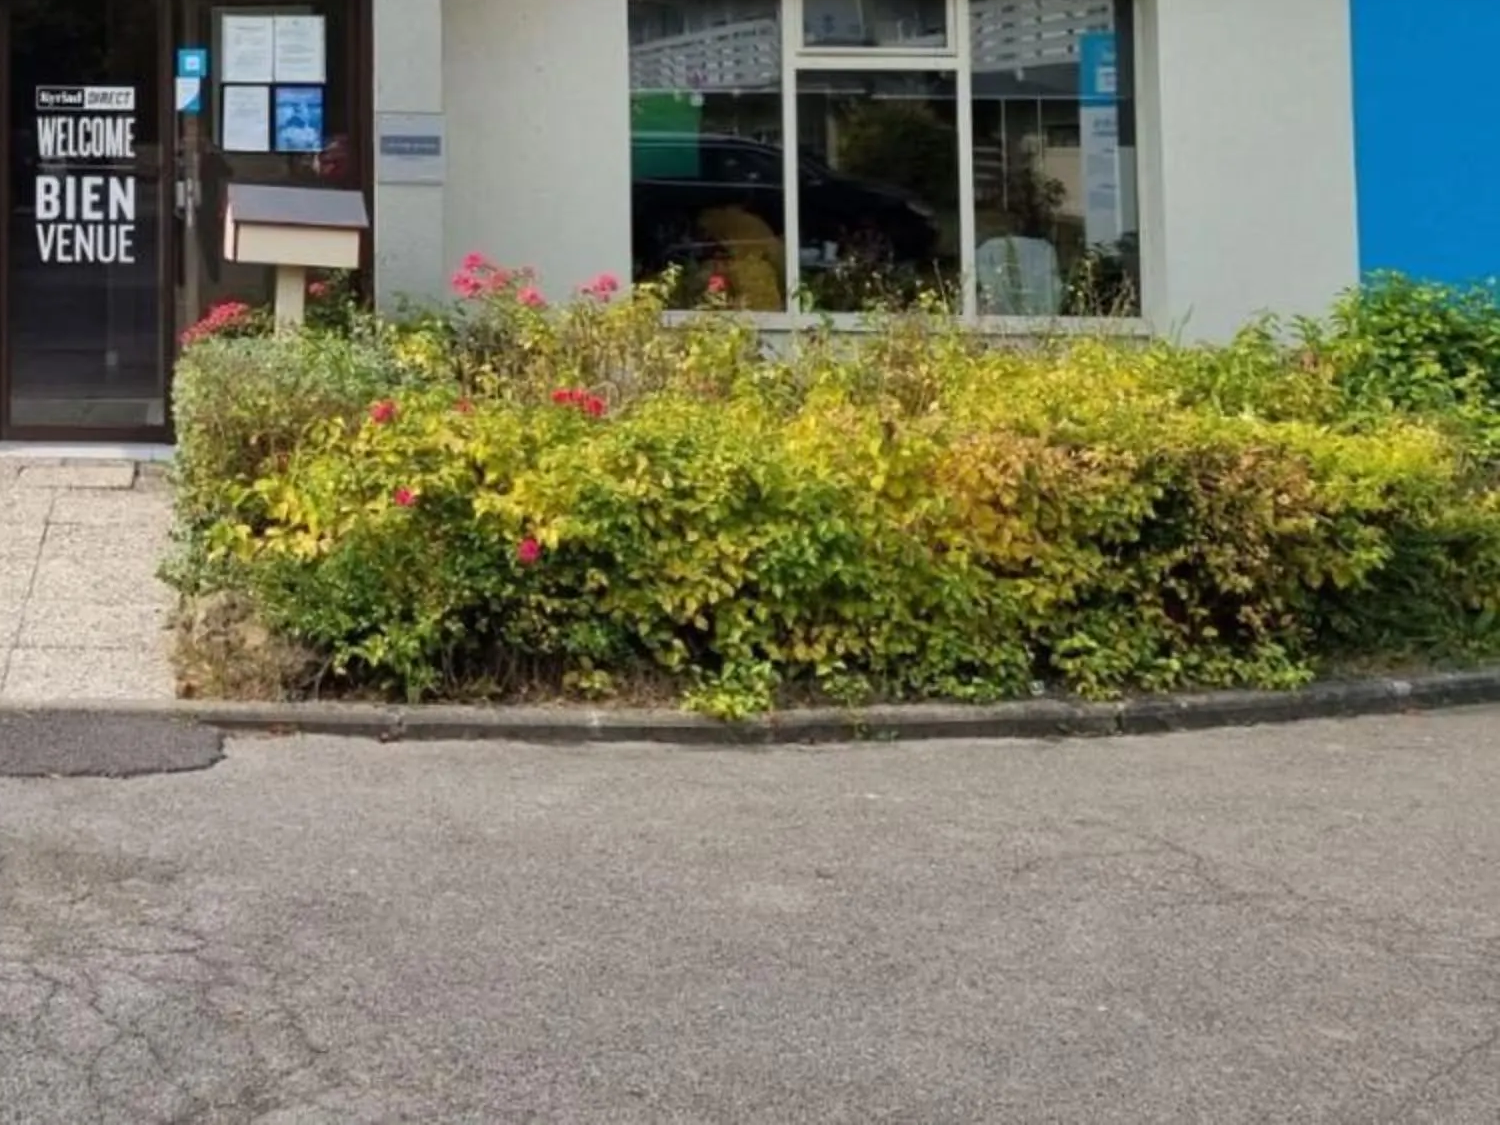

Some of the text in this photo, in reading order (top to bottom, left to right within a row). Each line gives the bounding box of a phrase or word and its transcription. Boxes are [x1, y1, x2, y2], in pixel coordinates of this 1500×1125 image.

[41, 90, 132, 106] Kyriad DIRECT
[37, 117, 136, 158] WELCOME
[36, 176, 135, 221] BIEN
[36, 224, 135, 263] VENUE
